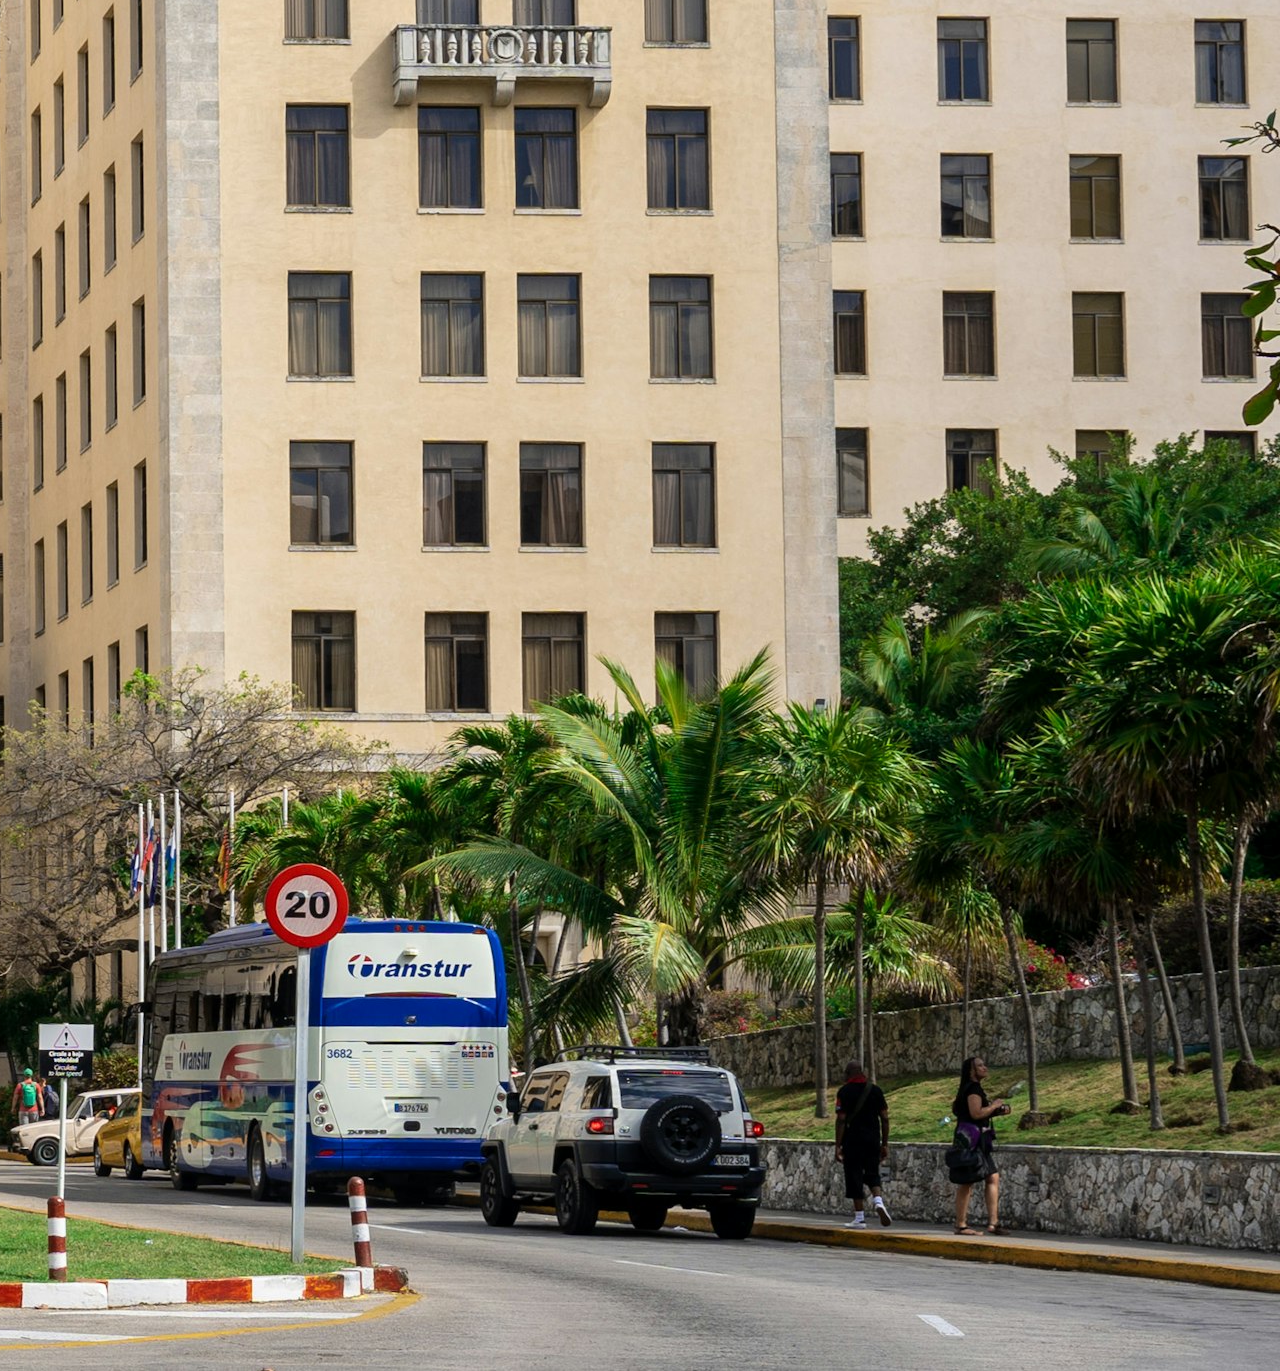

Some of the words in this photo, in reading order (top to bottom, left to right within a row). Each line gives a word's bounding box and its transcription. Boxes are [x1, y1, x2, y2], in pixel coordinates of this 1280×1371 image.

[284, 890, 331, 919] 20
[327, 1049, 353, 1059] 3682
[433, 1127, 477, 1135] YUTONG
